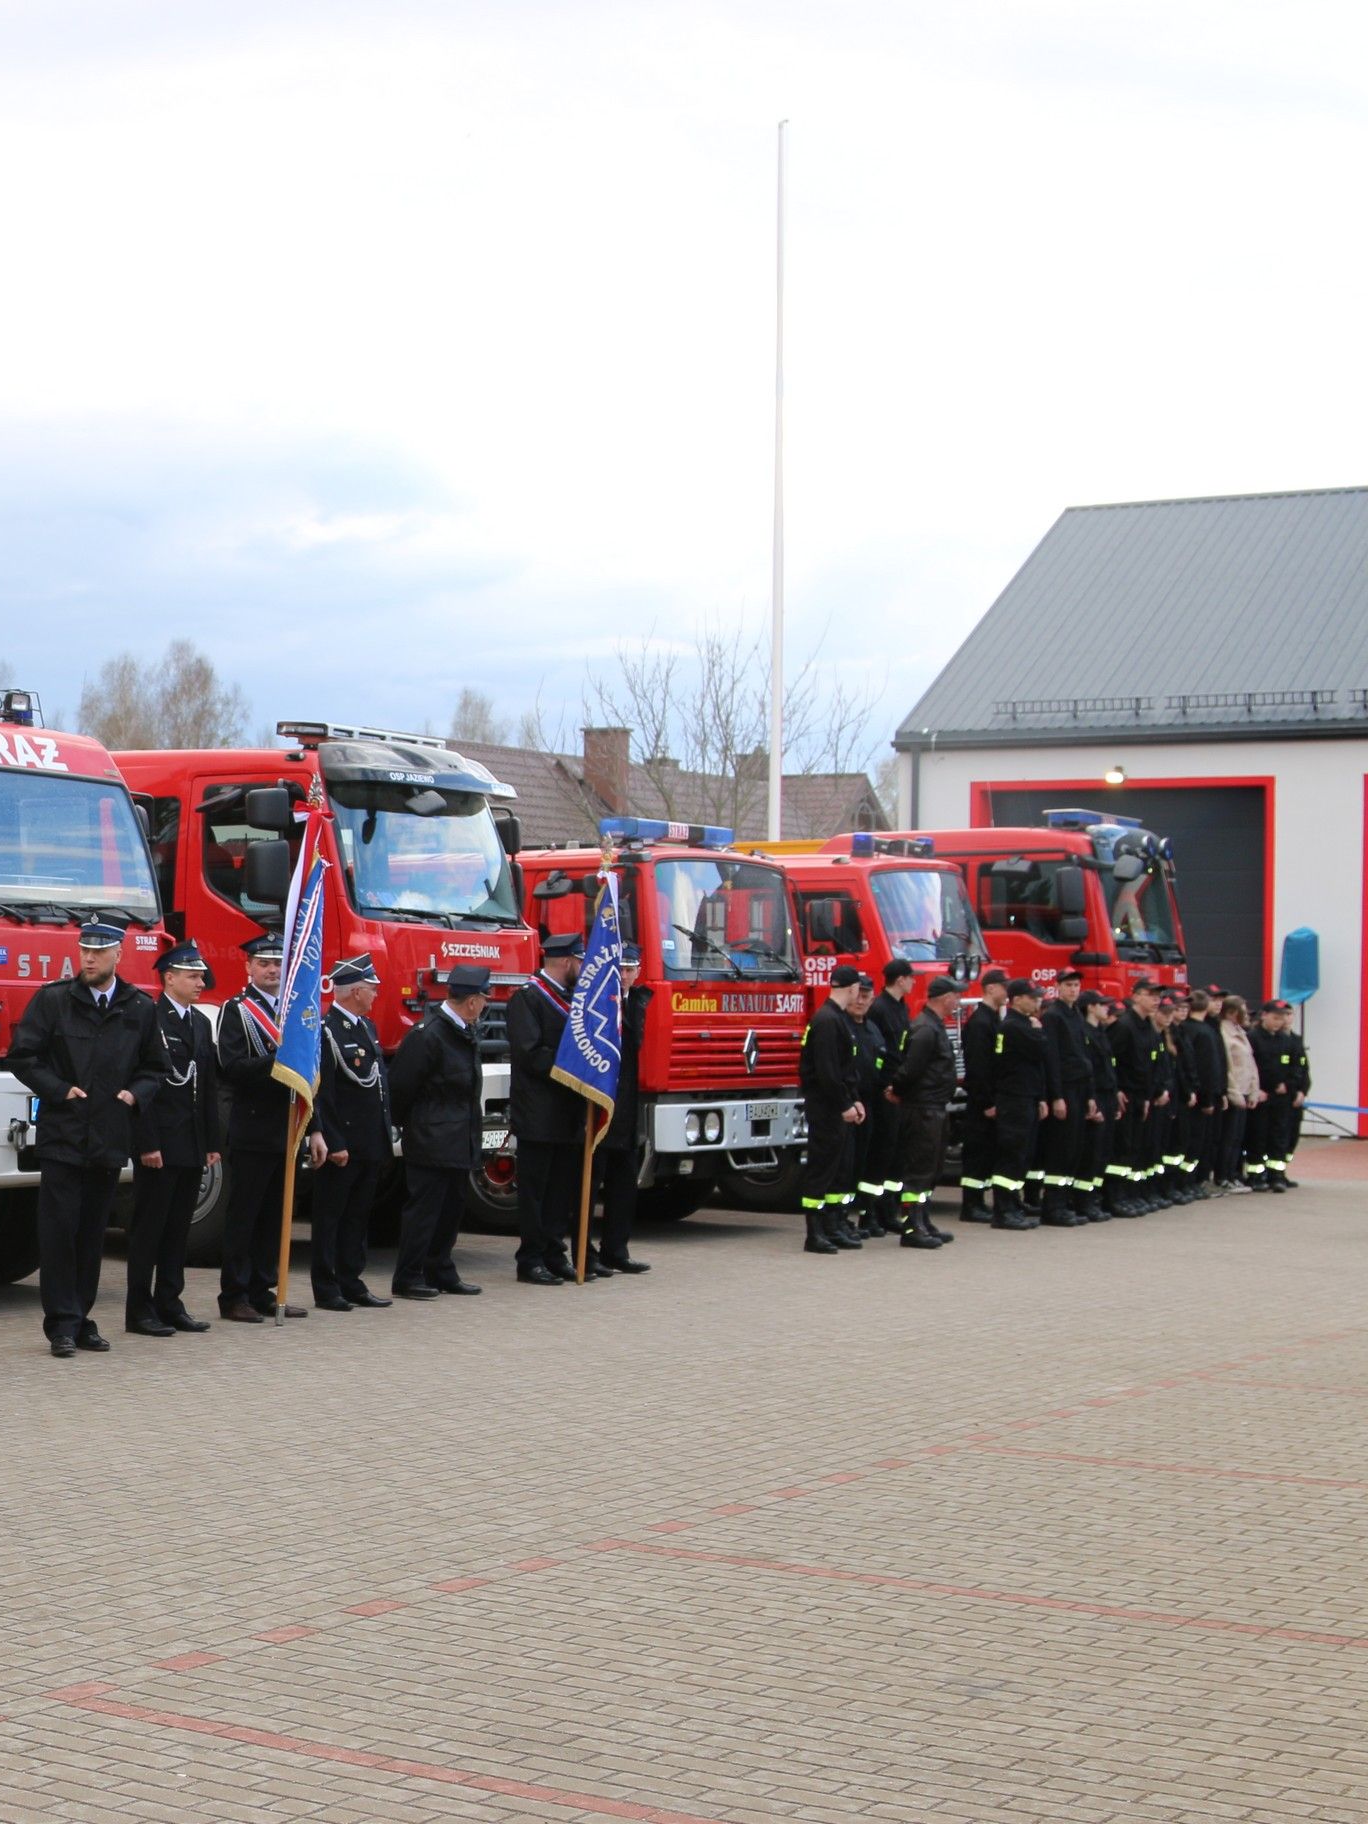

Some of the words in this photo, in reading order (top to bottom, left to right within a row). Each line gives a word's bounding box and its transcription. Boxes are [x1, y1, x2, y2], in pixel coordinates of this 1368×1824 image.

[389, 772, 405, 781] OSP
[448, 942, 500, 960] SZCZĘŚNIAK
[17, 954, 75, 979] STA
[580, 945, 614, 989] STRAŻ
[804, 957, 837, 971] OSP
[1032, 968, 1057, 981] OSP
[671, 992, 717, 1012] Camiva
[721, 994, 776, 1013] RENAULT
[570, 991, 611, 1074] OCHOTNICZA
